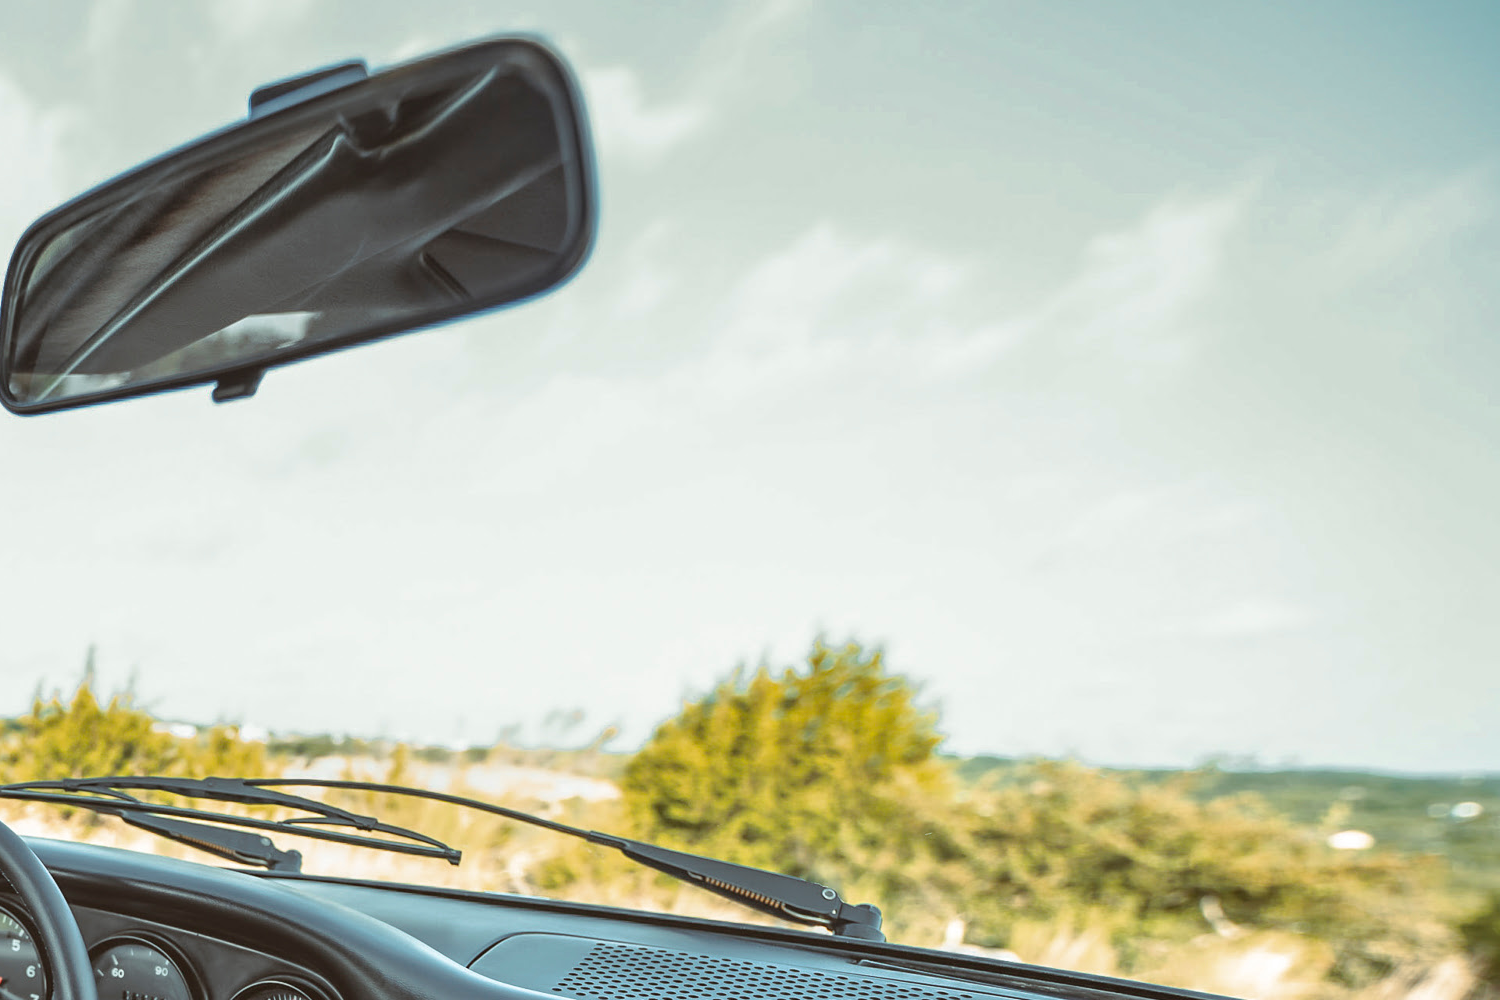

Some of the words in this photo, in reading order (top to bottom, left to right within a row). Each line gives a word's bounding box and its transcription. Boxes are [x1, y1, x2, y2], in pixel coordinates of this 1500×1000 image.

[12, 939, 20, 951] 5
[26, 965, 36, 977] 6
[111, 968, 124, 978] 60
[155, 966, 168, 976] 90
